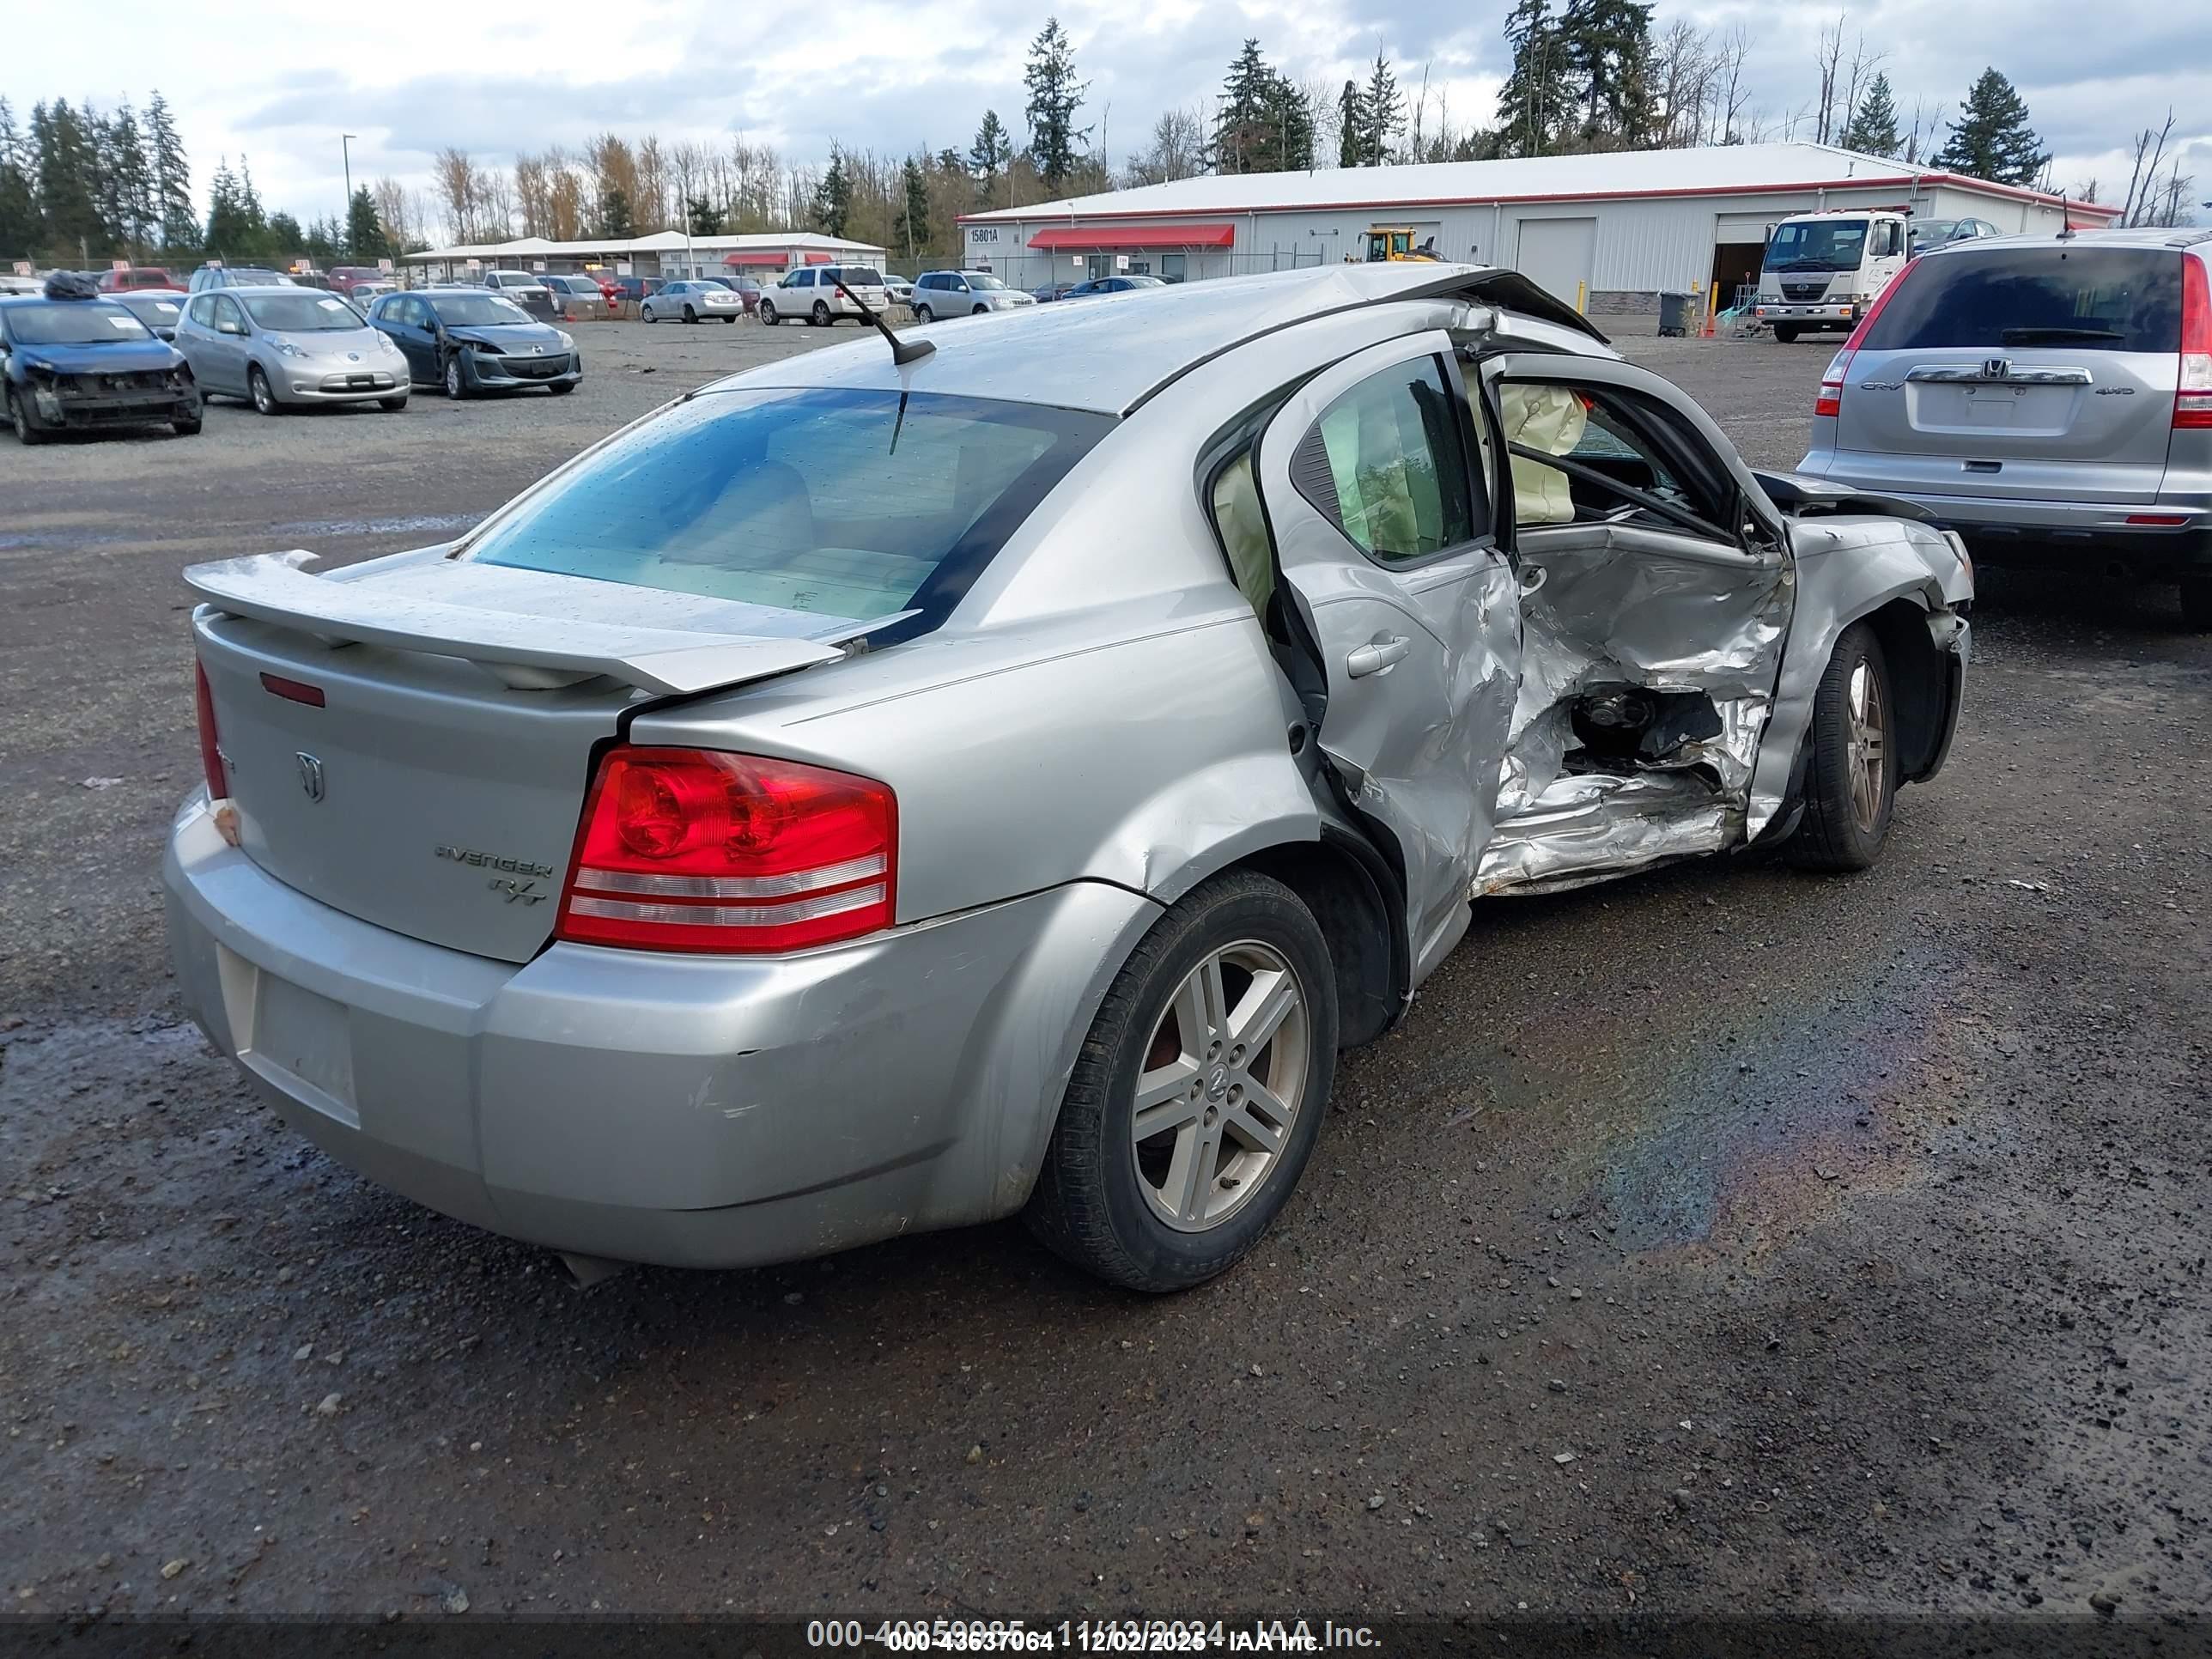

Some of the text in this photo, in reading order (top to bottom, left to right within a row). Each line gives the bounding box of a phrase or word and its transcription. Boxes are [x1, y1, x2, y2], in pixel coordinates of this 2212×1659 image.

[971, 228, 998, 242] 15801A
[2095, 387, 2136, 396] 4WD
[434, 845, 553, 878] AVENGER
[489, 877, 547, 907] R/T
